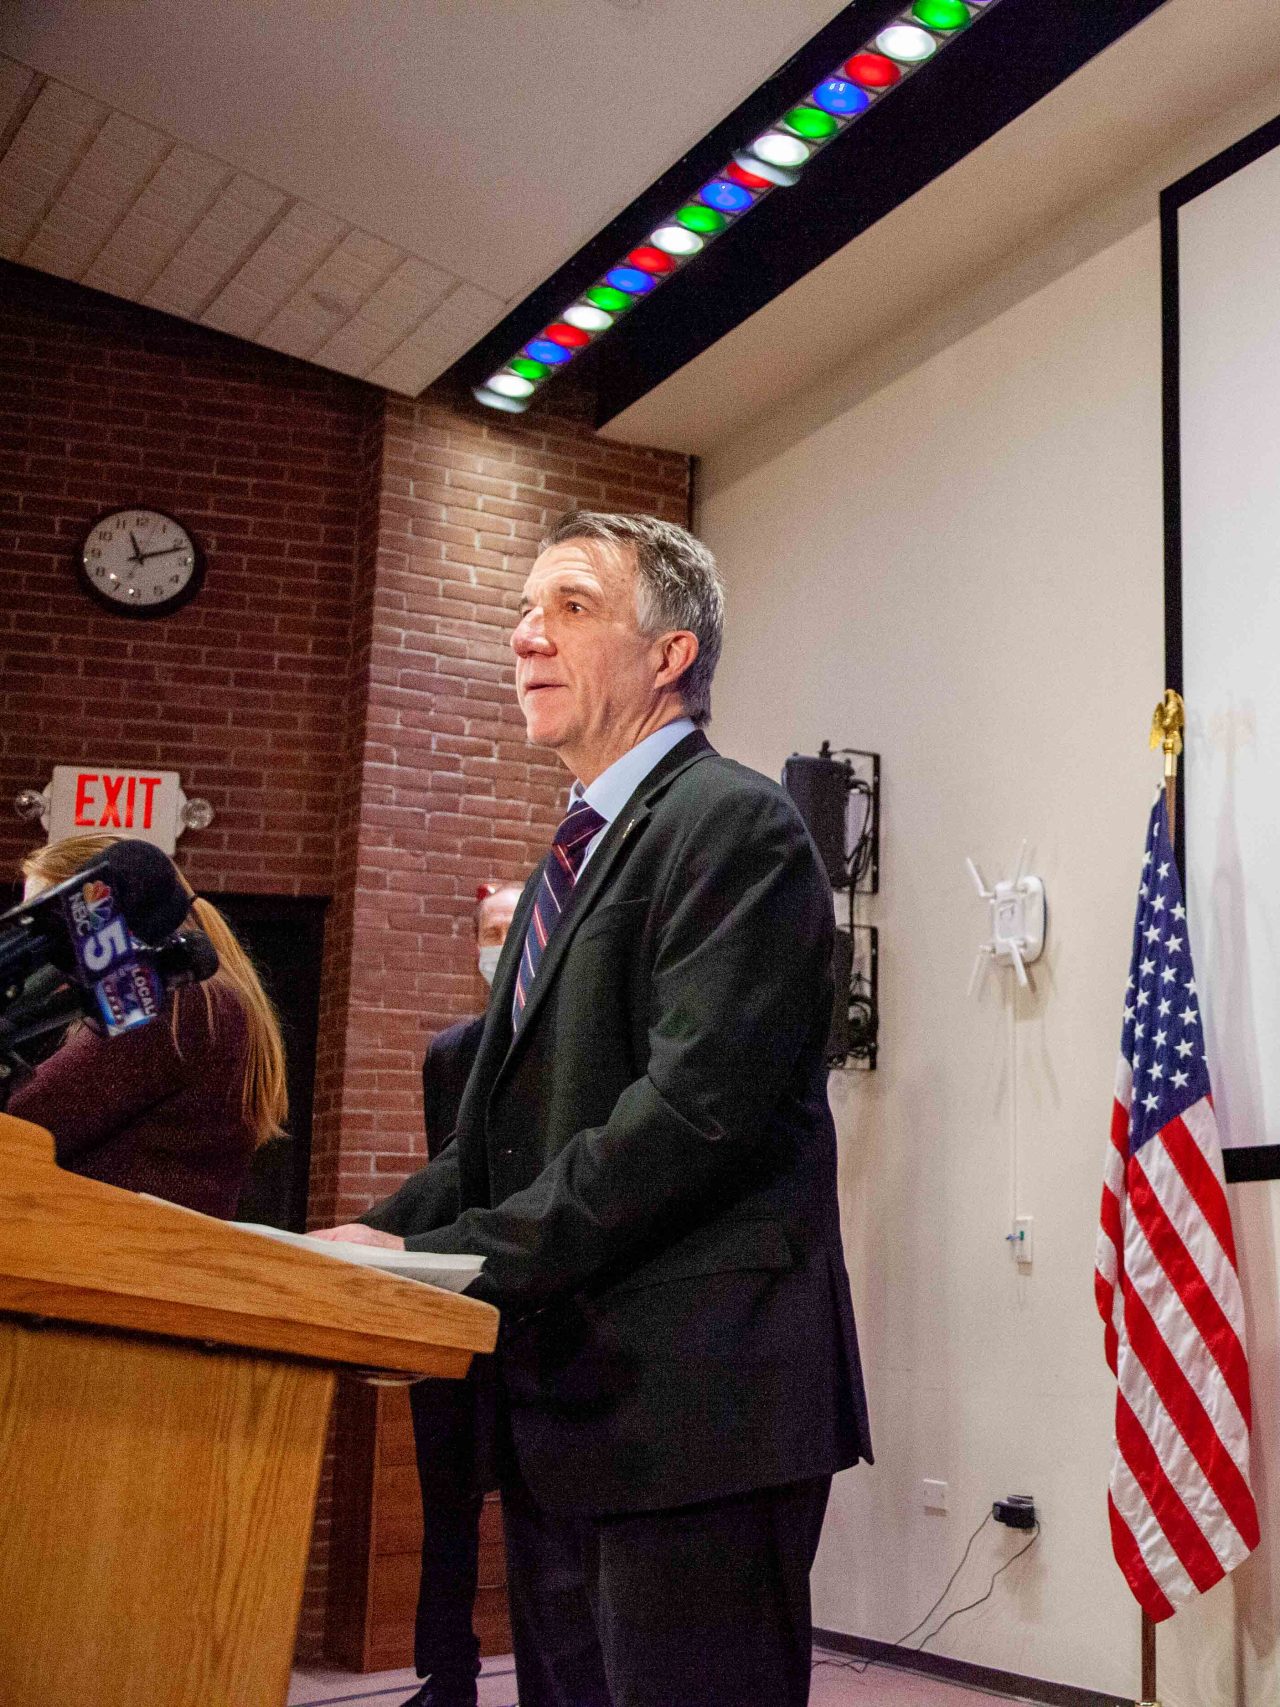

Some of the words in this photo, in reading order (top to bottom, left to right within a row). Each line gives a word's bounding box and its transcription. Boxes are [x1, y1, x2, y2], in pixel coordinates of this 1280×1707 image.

[74, 774, 161, 828] EXIT
[68, 892, 91, 937] NBC
[85, 923, 128, 971] 5
[131, 966, 155, 1018] LOCAL
